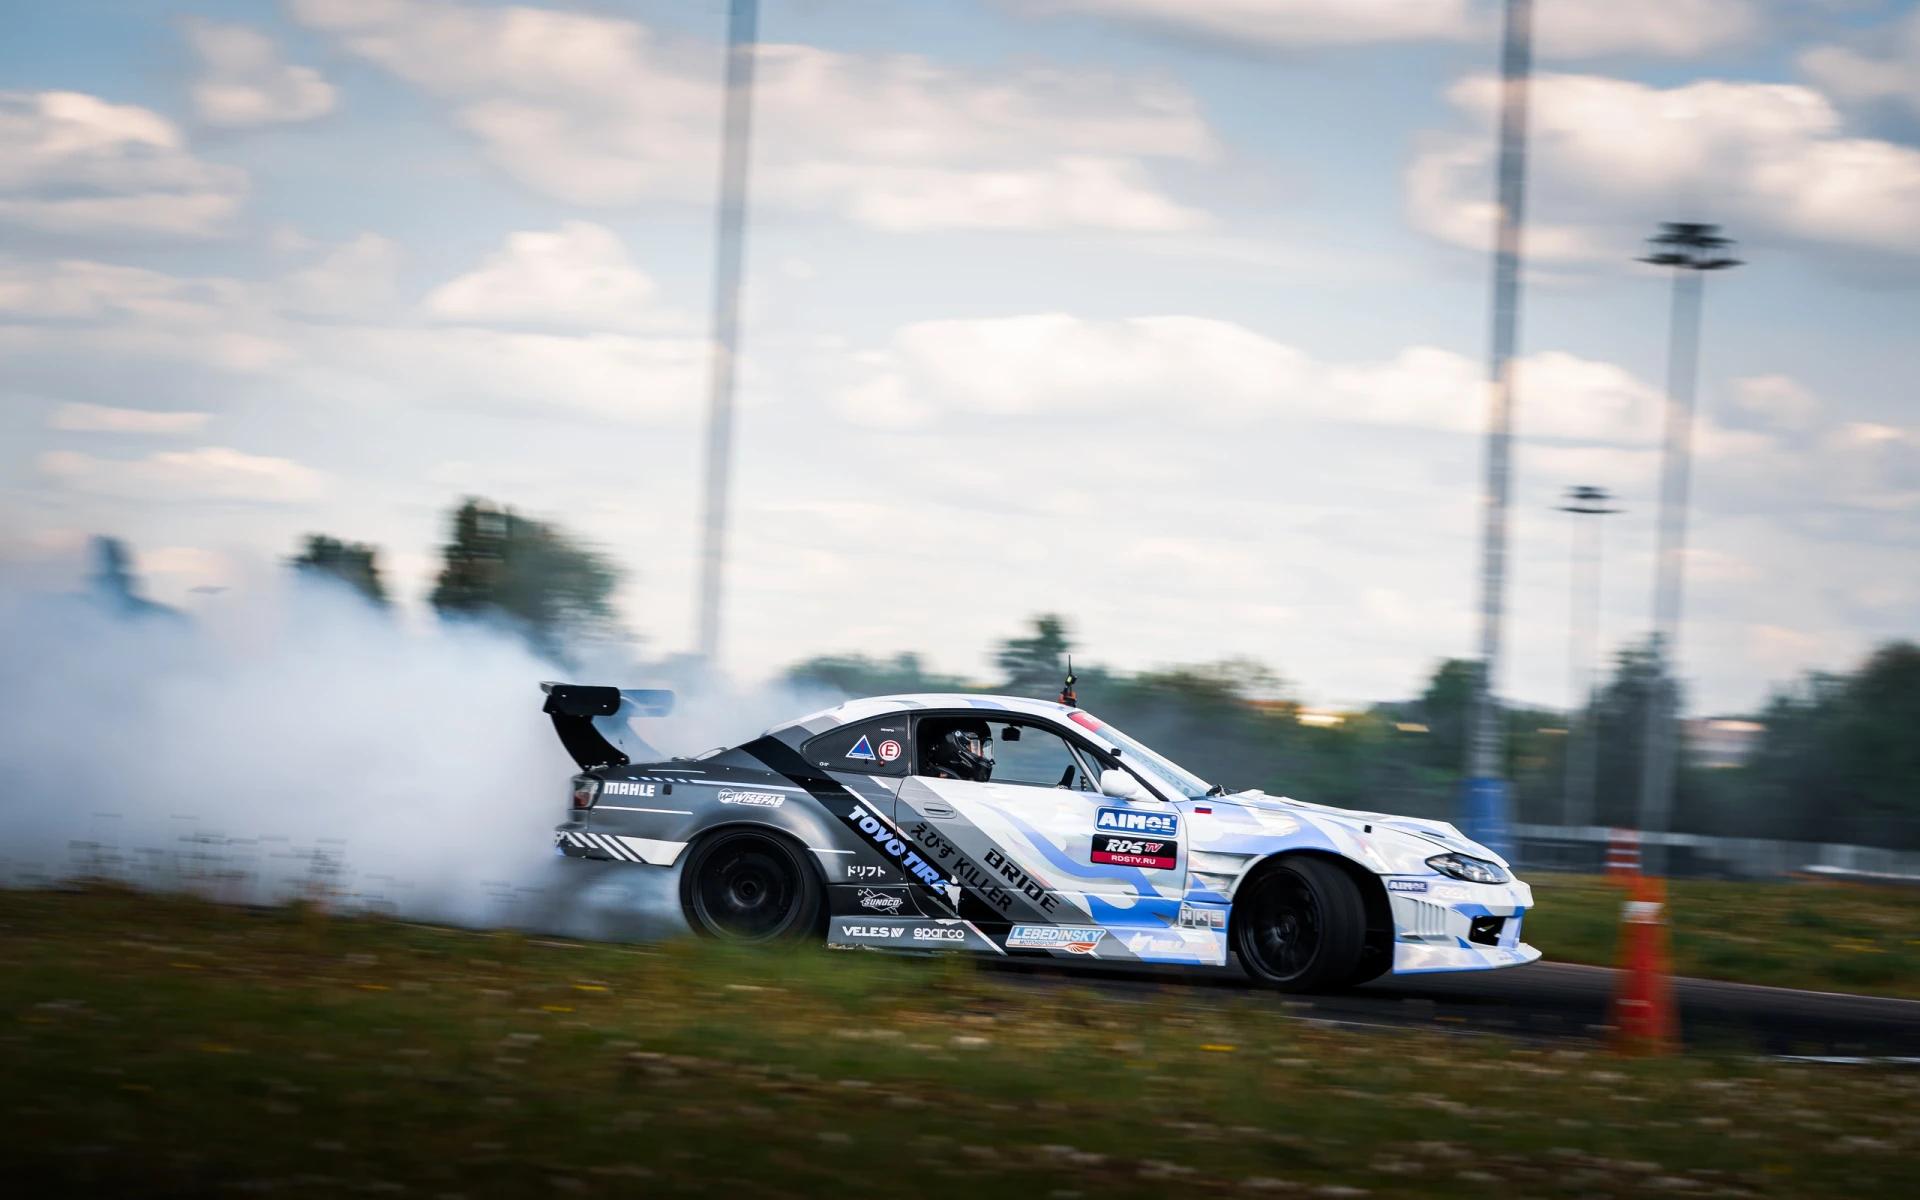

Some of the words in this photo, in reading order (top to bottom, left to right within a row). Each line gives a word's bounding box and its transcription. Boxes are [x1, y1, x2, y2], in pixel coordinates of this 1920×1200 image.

[885, 744, 894, 757] E
[603, 782, 656, 797] MAHLE
[733, 793, 785, 807] WISEFAB
[1098, 812, 1175, 833] AIMOL
[848, 804, 907, 857] TOYO
[1105, 838, 1146, 854] RDS
[1144, 842, 1164, 853] TV
[911, 822, 956, 859] えびす
[953, 857, 1013, 912] KILLER
[1111, 855, 1156, 865] RDSTV.RU
[847, 865, 886, 877] ドリフト
[984, 848, 1060, 914] BRIDE
[863, 897, 901, 907] SUNOCO
[1180, 909, 1224, 922] HKS
[842, 926, 890, 938] VELES
[913, 927, 965, 941] sparco
[1013, 927, 1102, 942] LEBEDINSKY
